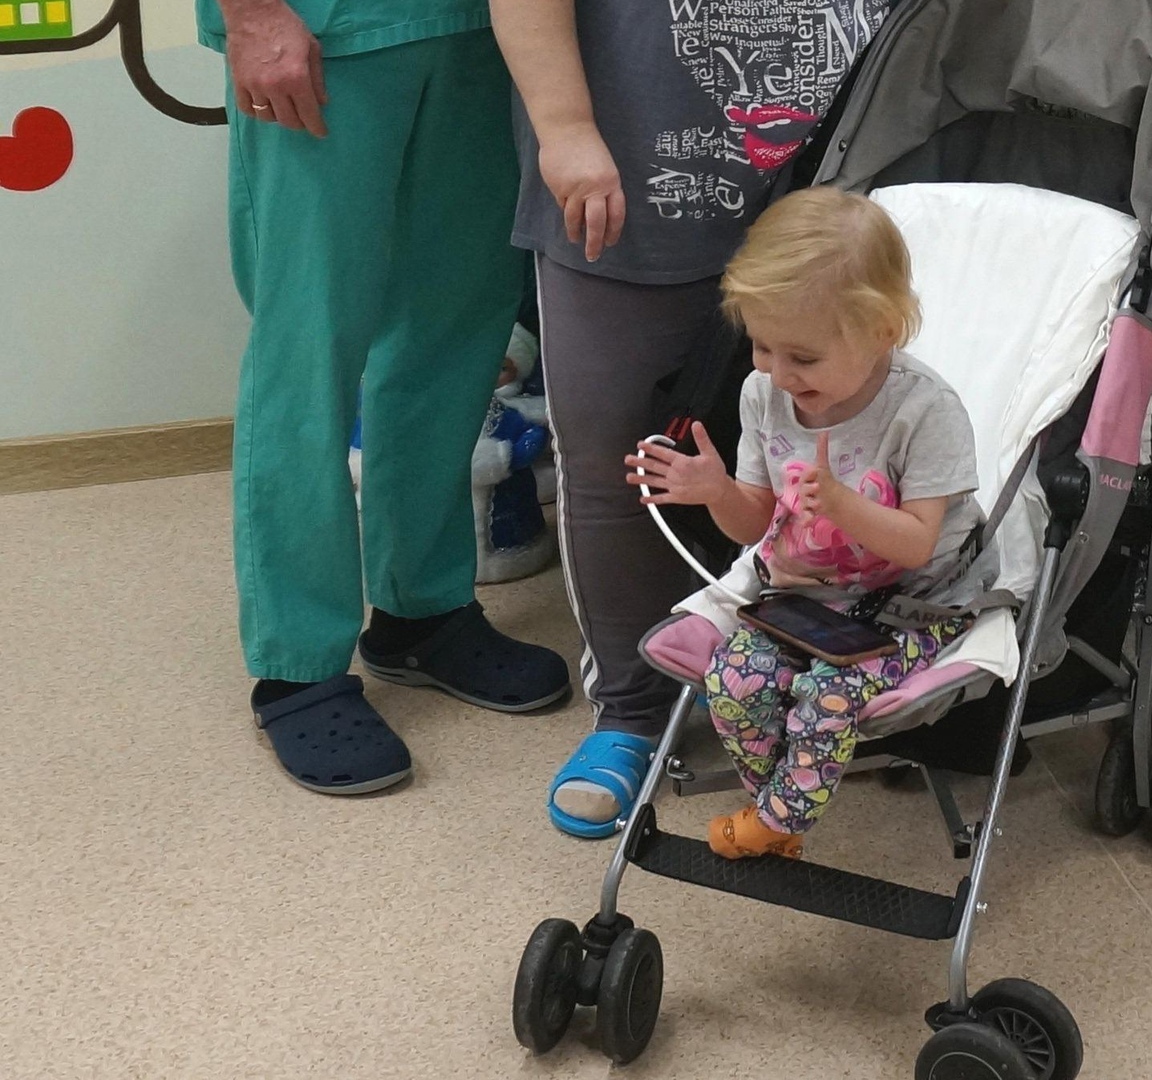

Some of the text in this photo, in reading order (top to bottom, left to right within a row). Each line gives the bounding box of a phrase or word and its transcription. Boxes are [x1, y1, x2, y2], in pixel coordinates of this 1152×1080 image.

[710, 1, 760, 16] Person
[709, 19, 798, 38] Strangers Shy
[709, 32, 733, 44] Way
[815, 23, 826, 65] Thought
[832, 39, 841, 67] Need
